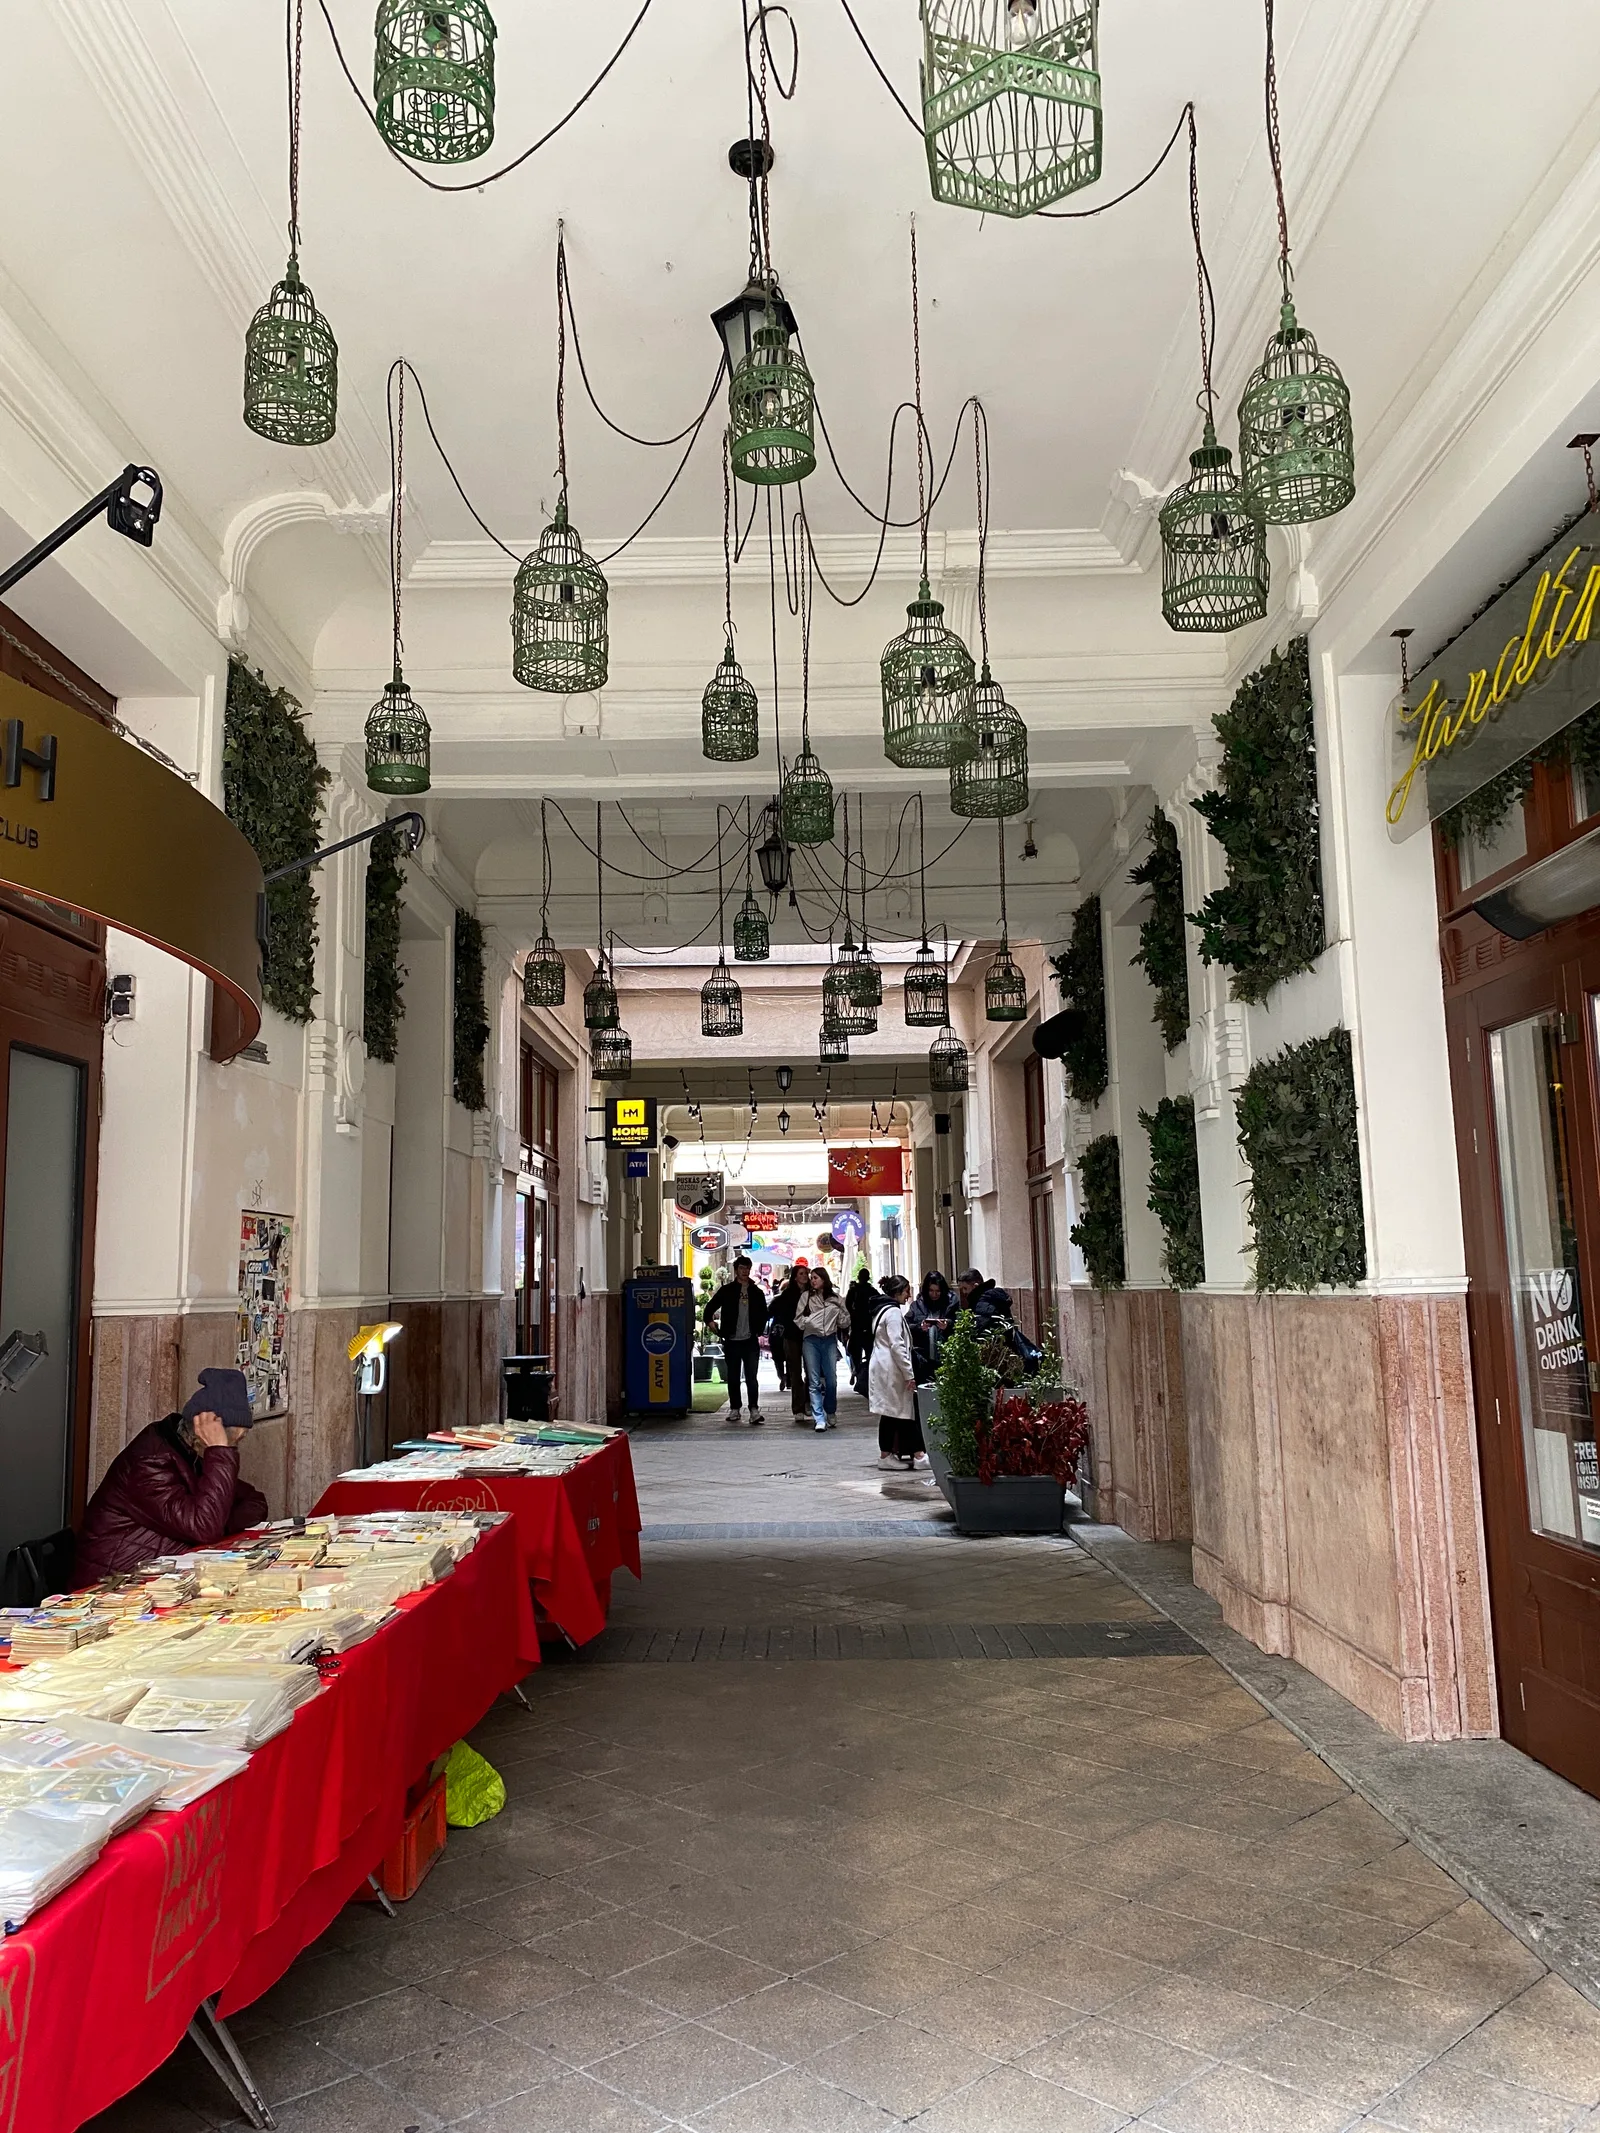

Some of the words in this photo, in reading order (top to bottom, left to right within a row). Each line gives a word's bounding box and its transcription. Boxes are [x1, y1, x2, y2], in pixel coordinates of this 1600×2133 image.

[612, 1126, 649, 1136] HOME
[676, 1176, 700, 1184] PUSKÁS
[695, 1205, 703, 1215] 10
[834, 1214, 848, 1229] BLUE
[849, 1214, 862, 1229] BIRD
[661, 1287, 685, 1297] EUR
[1529, 1269, 1573, 1322] NO
[661, 1298, 685, 1308] HUF
[1535, 1313, 1581, 1351] DRINK
[1541, 1343, 1584, 1370] OUTSIDE
[655, 1360, 663, 1388] ATM
[1574, 1441, 1598, 1460] FREE
